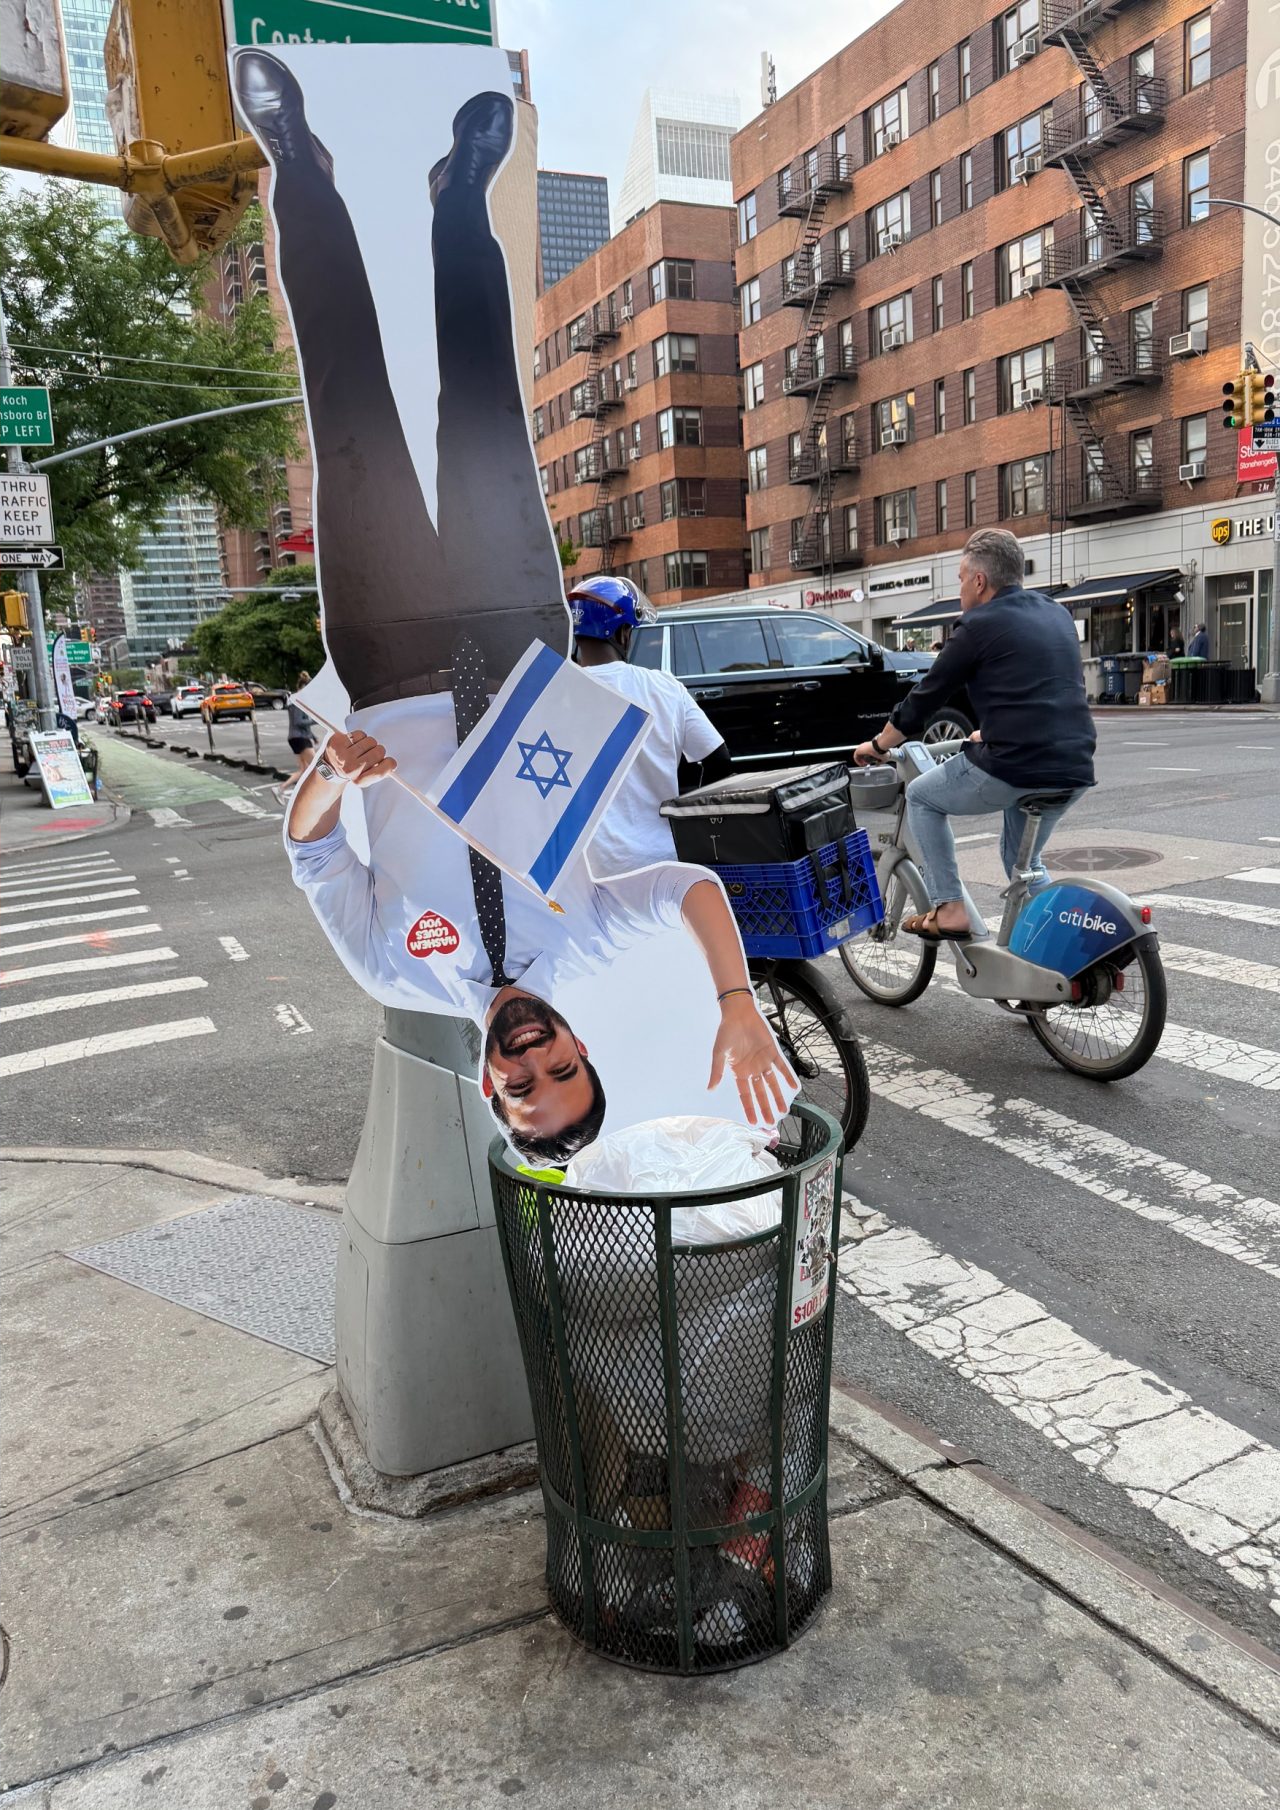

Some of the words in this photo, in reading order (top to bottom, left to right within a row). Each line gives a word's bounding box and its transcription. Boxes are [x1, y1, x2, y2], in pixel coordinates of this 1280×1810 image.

[2, 395, 28, 406] Koch
[36, 410, 48, 420] Br
[14, 425, 41, 437] LEFT
[1, 480, 37, 492] THRU
[1, 495, 47, 507] RAFFIC
[4, 510, 39, 521] KEEP
[3, 525, 42, 536] RIGHT
[1235, 518, 1262, 537] THE
[1, 554, 22, 562] ONE
[31, 553, 52, 562] WAY
[418, 917, 443, 930] YOU
[410, 935, 458, 951] HASHEM
